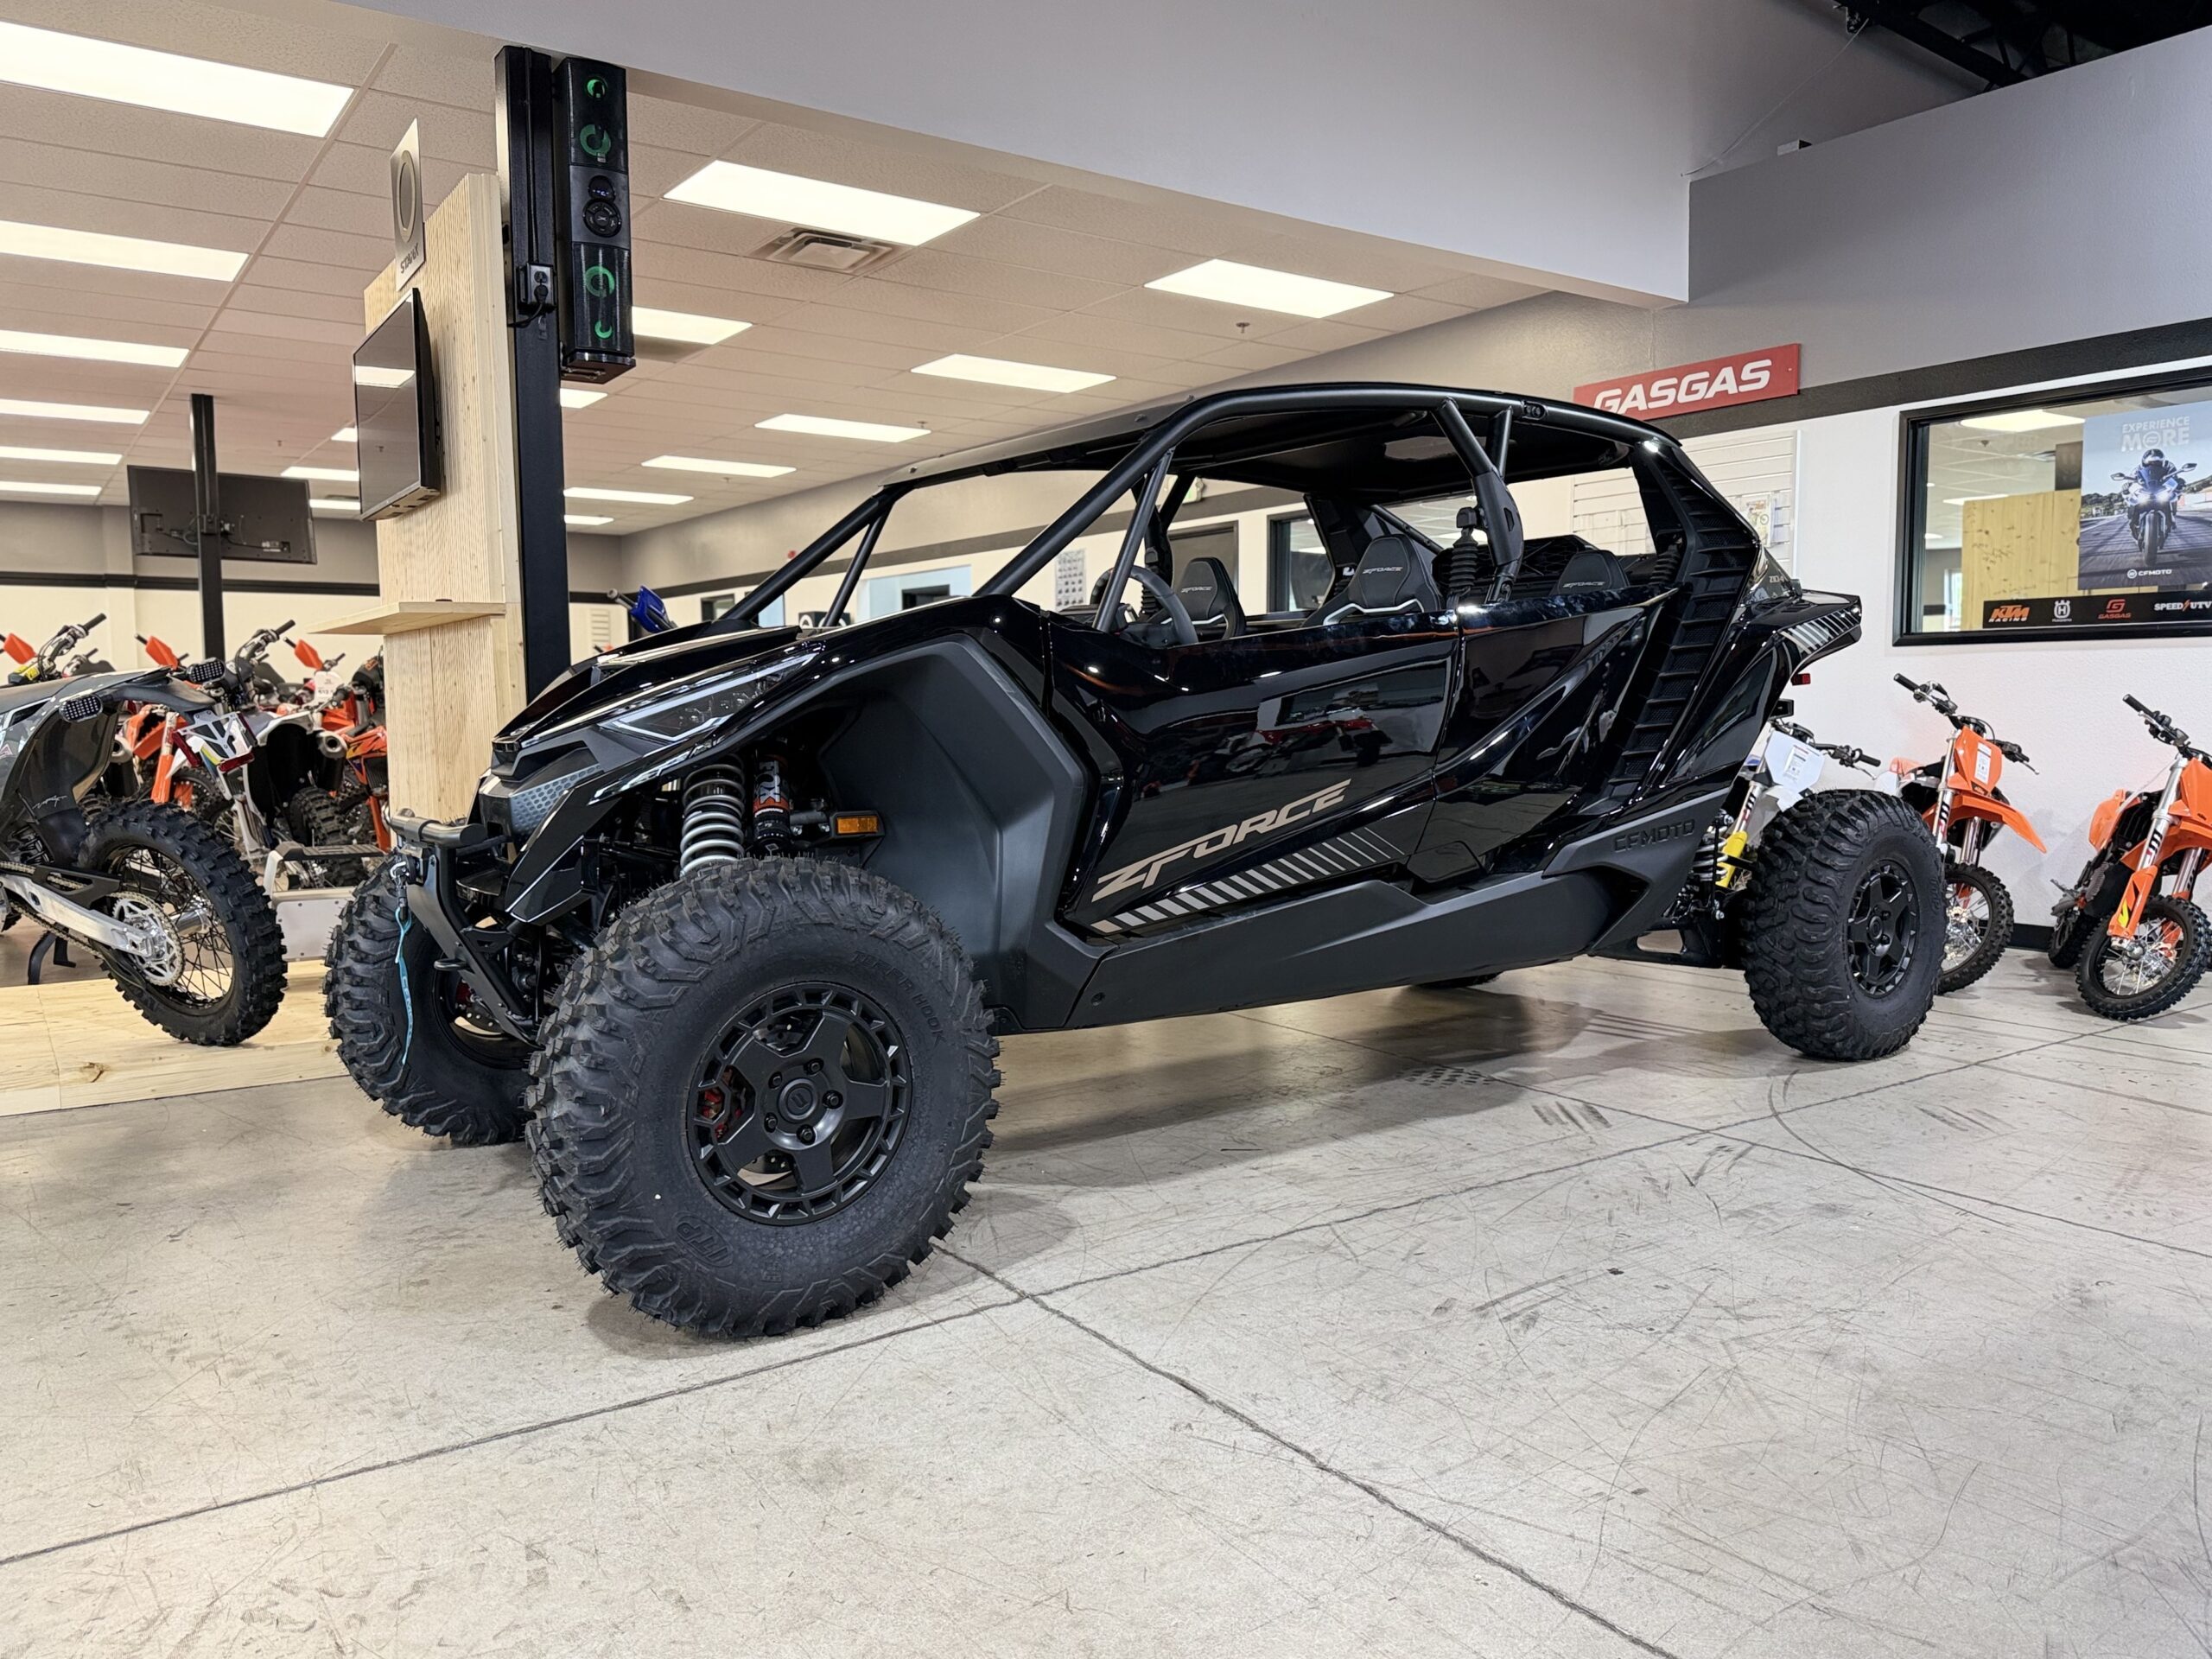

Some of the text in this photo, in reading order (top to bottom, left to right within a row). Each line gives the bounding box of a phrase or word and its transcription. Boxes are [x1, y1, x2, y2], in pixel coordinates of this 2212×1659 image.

[1593, 359, 1771, 415] GASGAS
[2122, 416, 2190, 433] EXPERIENCE
[1991, 605, 2031, 619] KTM
[1092, 779, 1351, 903] ZFORCE
[1614, 819, 1695, 853] CFMOTO
[912, 994, 948, 1048] HOOK
[677, 1222, 728, 1262] ITP
